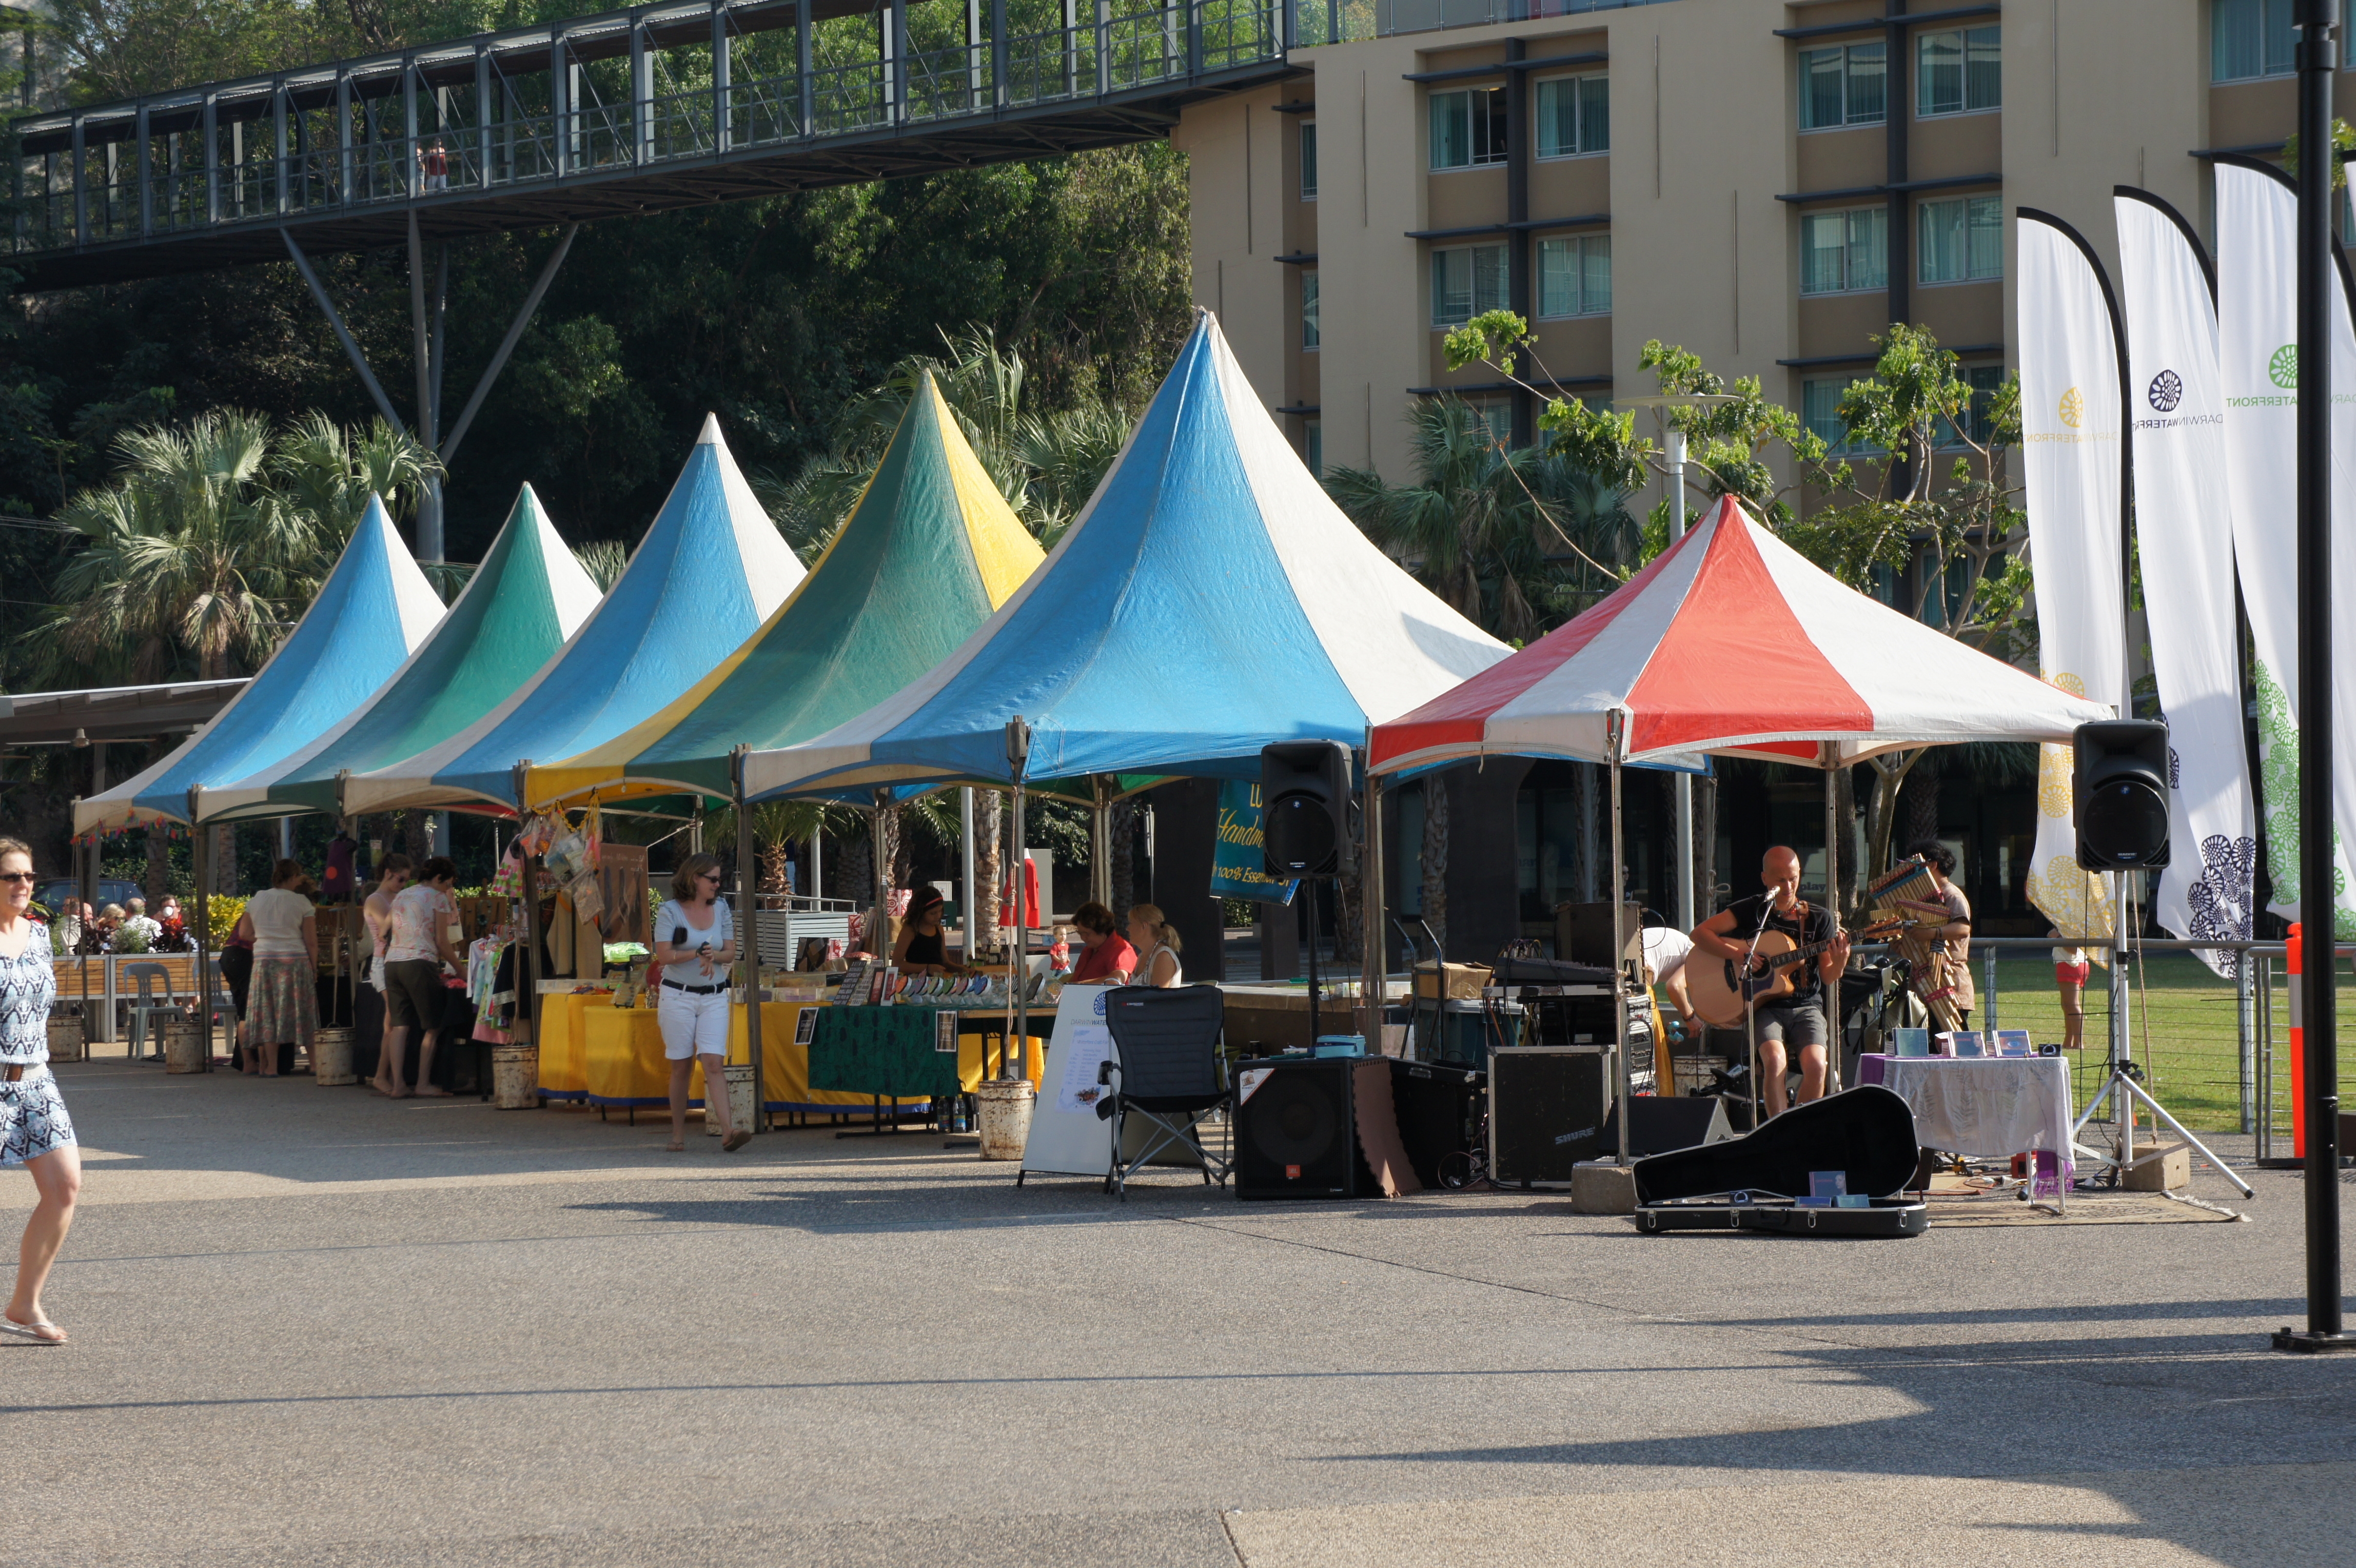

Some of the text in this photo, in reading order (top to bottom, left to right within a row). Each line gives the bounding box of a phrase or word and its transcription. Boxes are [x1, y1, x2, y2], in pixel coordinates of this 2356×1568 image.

[1219, 867, 1244, 880] 100%
[1242, 867, 1276, 884] Essen
[1555, 1127, 1594, 1145] SHURE
